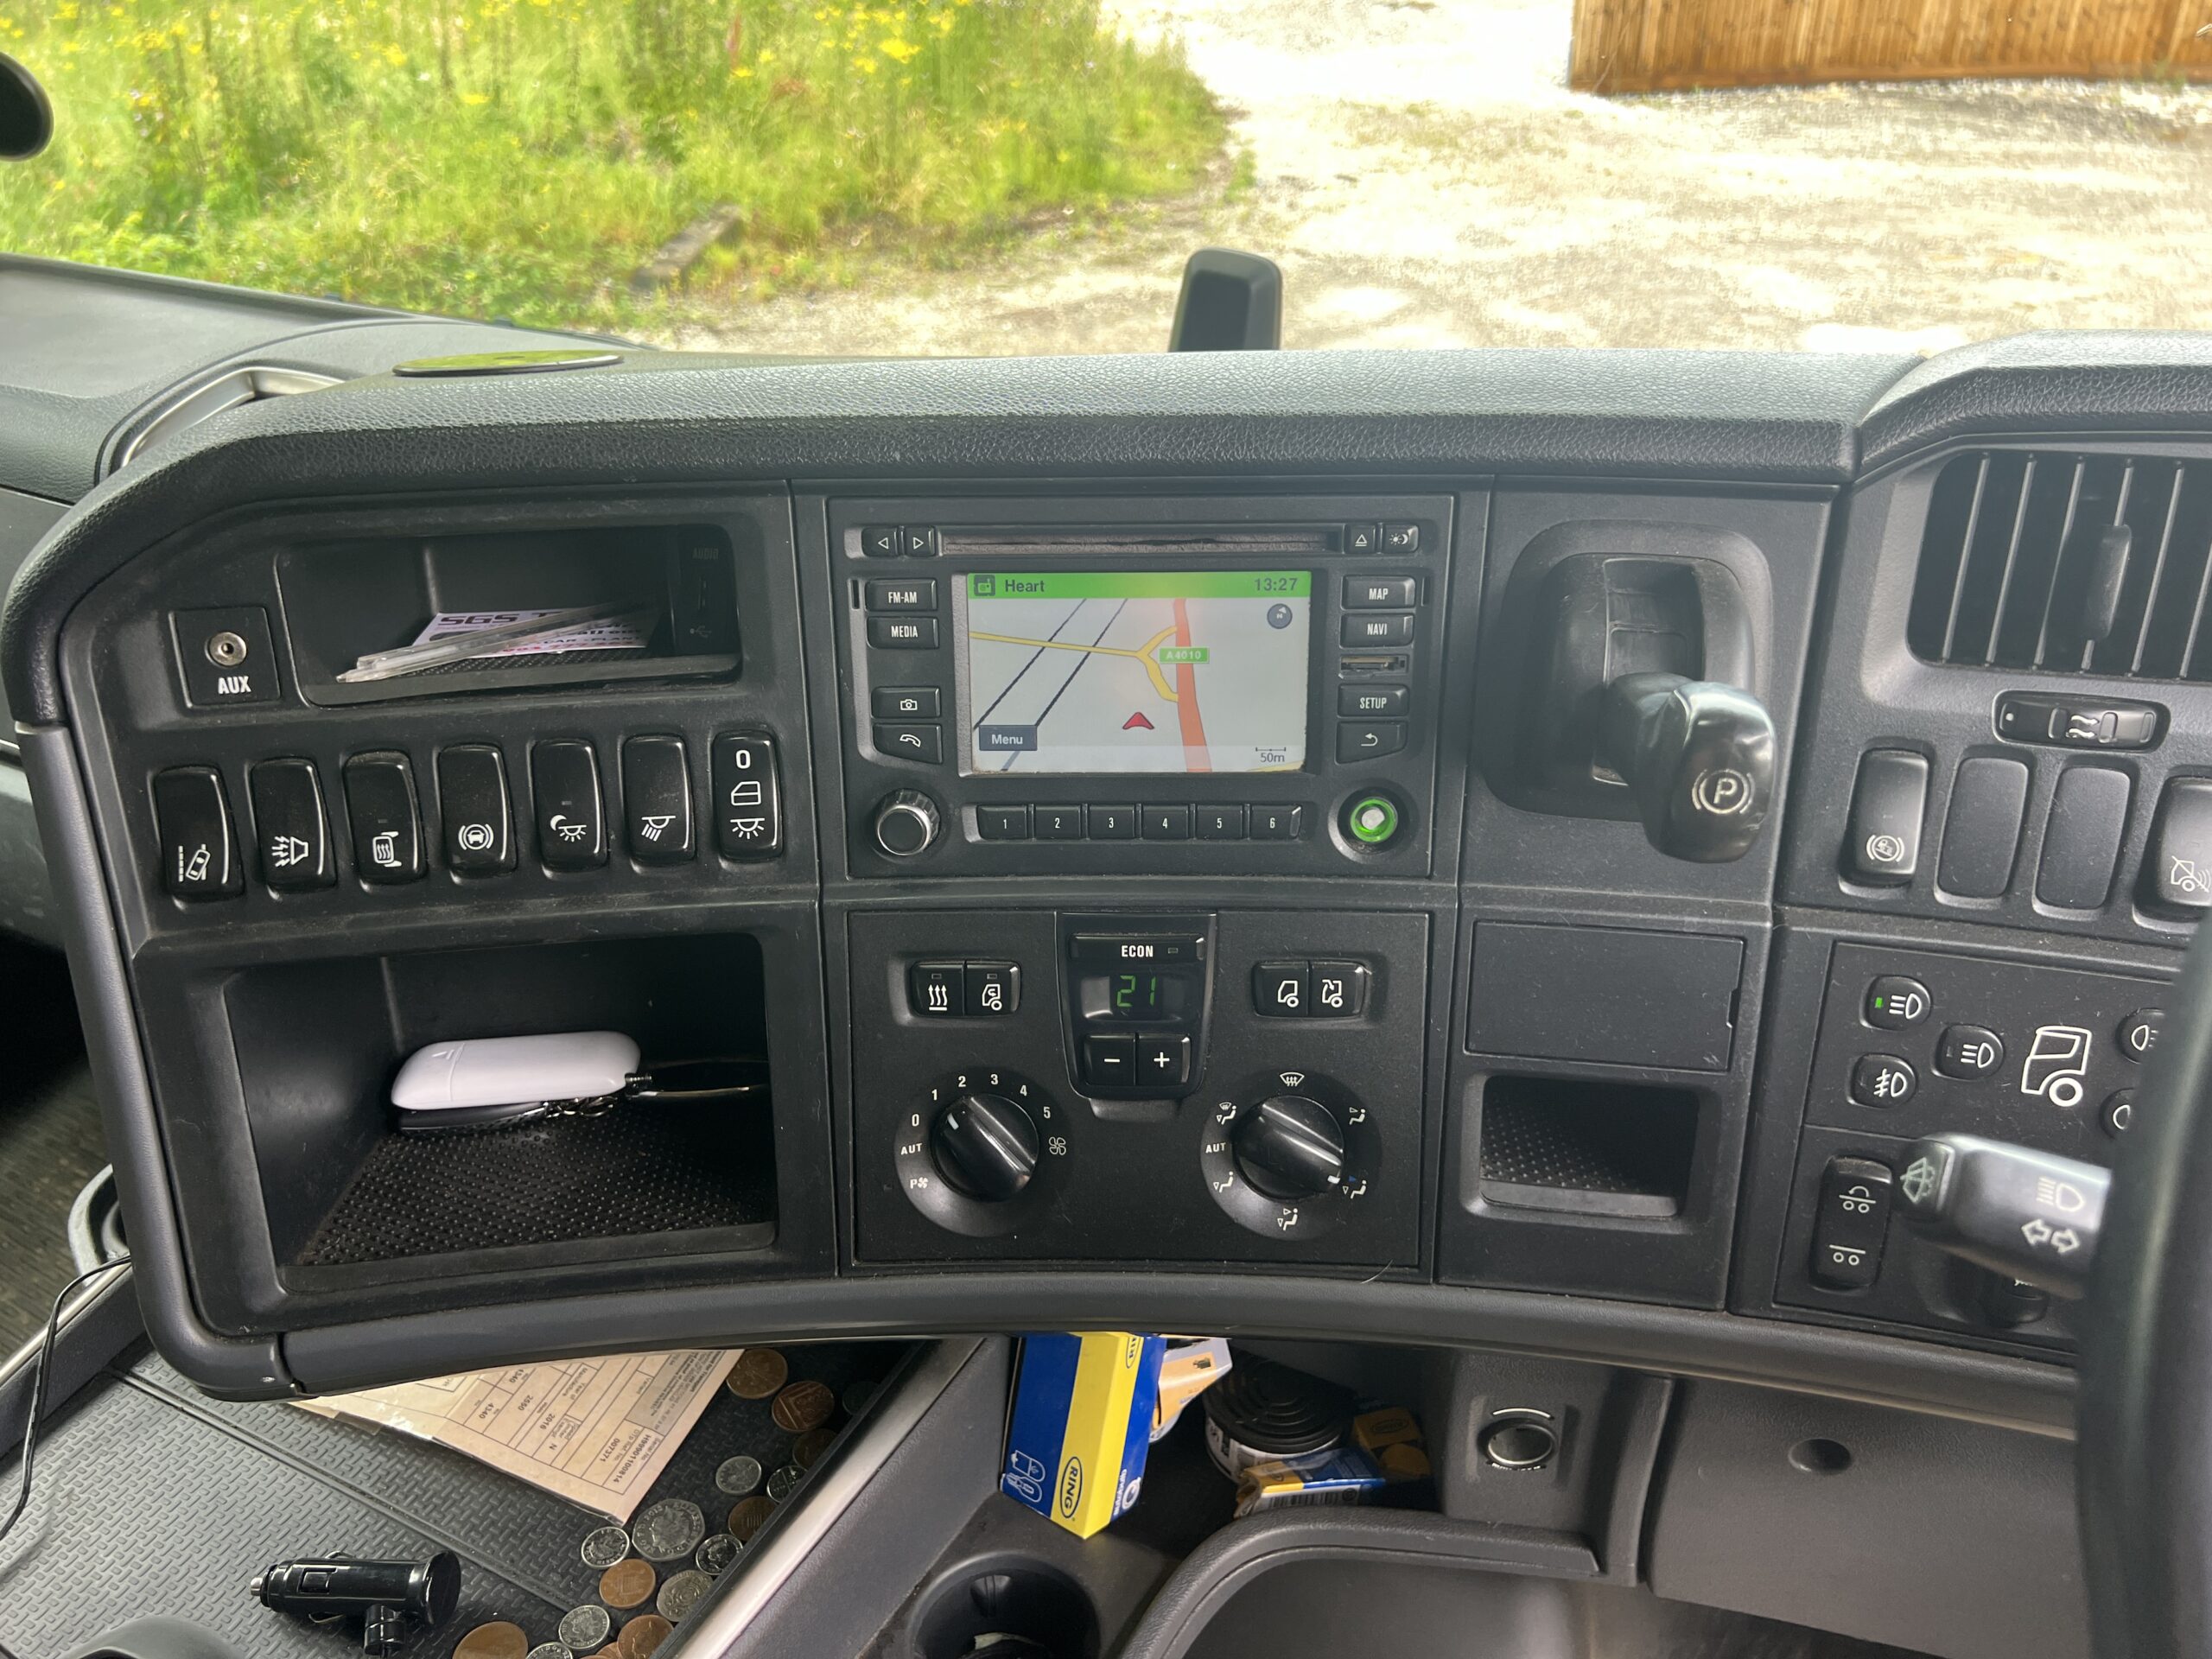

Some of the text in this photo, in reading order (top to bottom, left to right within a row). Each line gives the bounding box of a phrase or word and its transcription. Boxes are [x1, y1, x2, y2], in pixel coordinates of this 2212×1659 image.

[691, 548, 720, 560] AUDIO
[1004, 578, 1046, 594] Heart
[1254, 577, 1298, 592] 13:27
[887, 591, 918, 604] FM-AM
[1369, 588, 1389, 601] MAP
[438, 613, 520, 626] SGS
[891, 625, 918, 638] MEDIA
[1367, 623, 1388, 635] NAVI
[1166, 650, 1202, 660] A4010
[218, 675, 251, 695] AUX
[1359, 696, 1387, 709] SETUP
[991, 734, 1023, 745] Menu
[1260, 753, 1286, 763] 50m
[1713, 778, 1738, 804] P
[1121, 944, 1154, 958] ECON
[1116, 975, 1156, 1007] 21
[957, 1075, 967, 1088] 2
[990, 1073, 999, 1085] 3
[931, 1089, 938, 1101] 1
[1020, 1084, 1027, 1096] 4
[1043, 1106, 1051, 1119] 5
[900, 1142, 923, 1155] AUT
[1205, 1142, 1227, 1154] AUT
[561, 1365, 588, 1398] Manufacture
[574, 1380, 586, 1395] Year
[478, 1401, 495, 1421] 4340
[538, 1411, 556, 1431] 2016
[548, 1441, 557, 1451] N
[599, 1436, 620, 1463] 007371
[1064, 1465, 1080, 1510] RING
